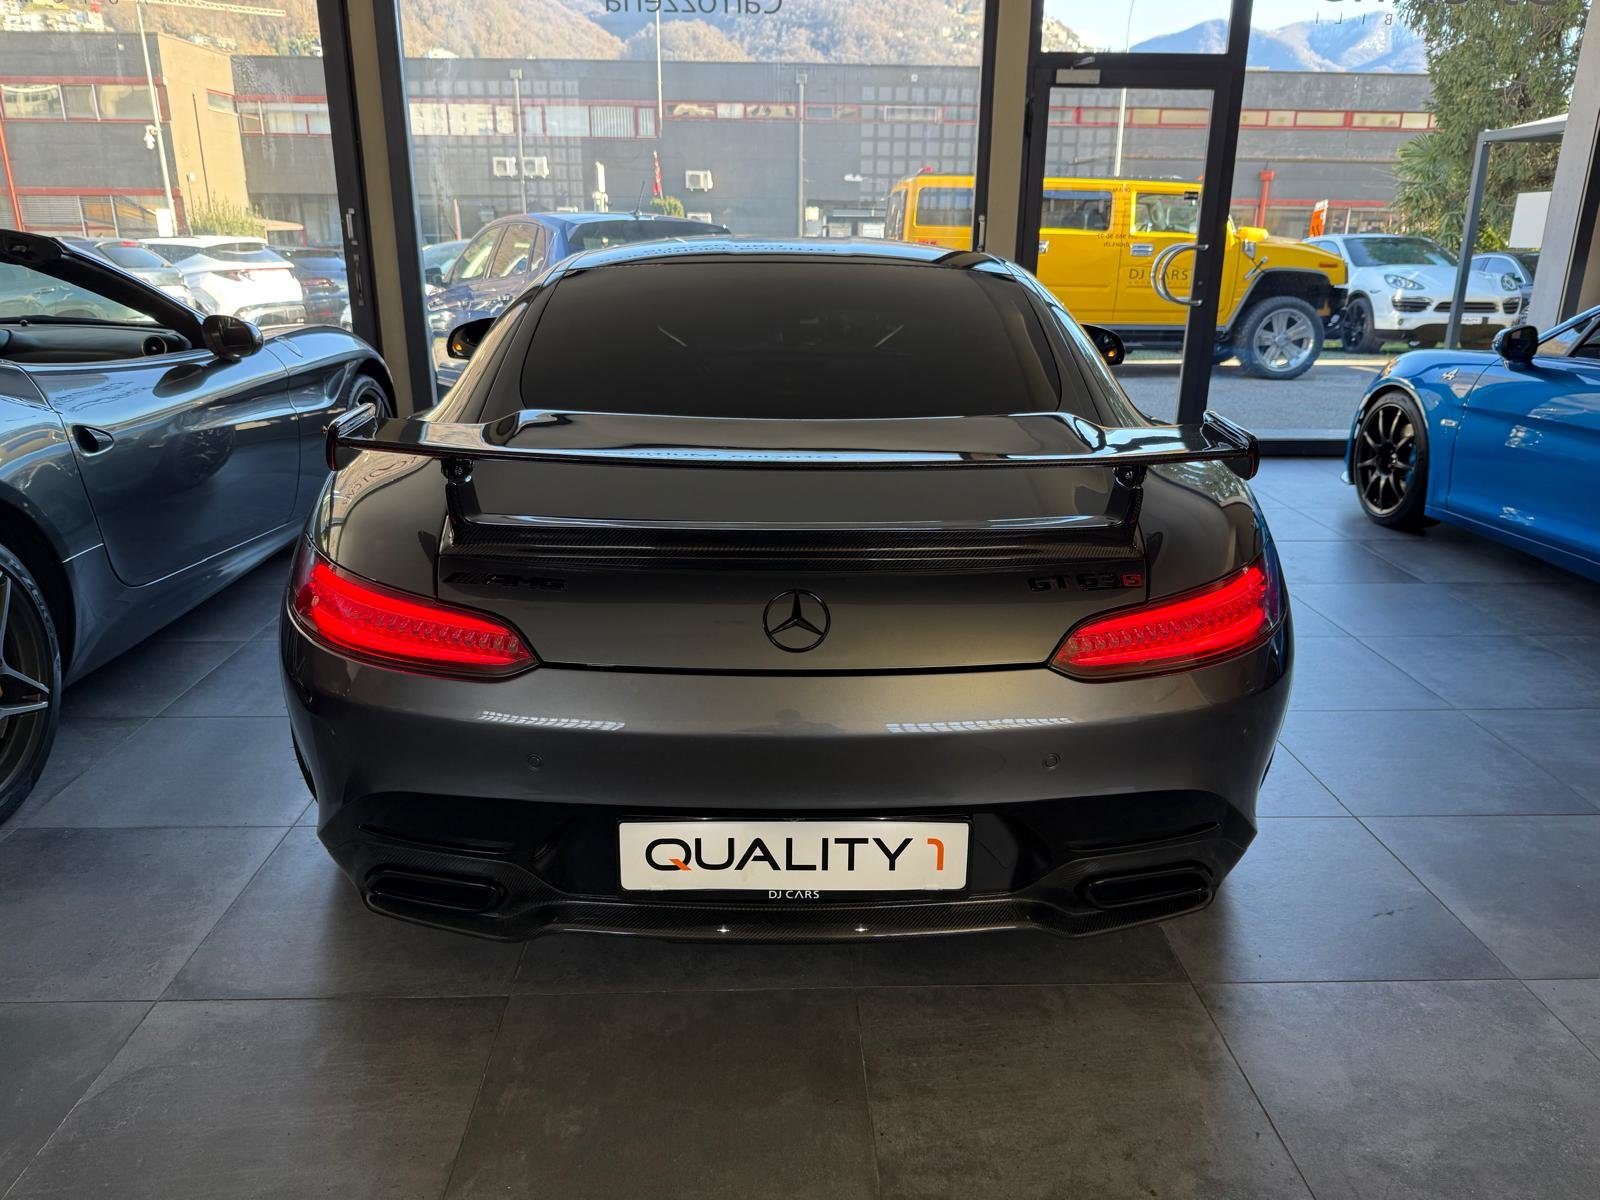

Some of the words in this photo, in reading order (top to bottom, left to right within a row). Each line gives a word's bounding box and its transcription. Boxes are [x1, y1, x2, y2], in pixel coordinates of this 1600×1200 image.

[1149, 269, 1188, 281] RS
[645, 837, 914, 871] QUALITY
[927, 837, 945, 871] 1
[768, 890, 782, 899] DJ
[785, 890, 820, 899] CARS
